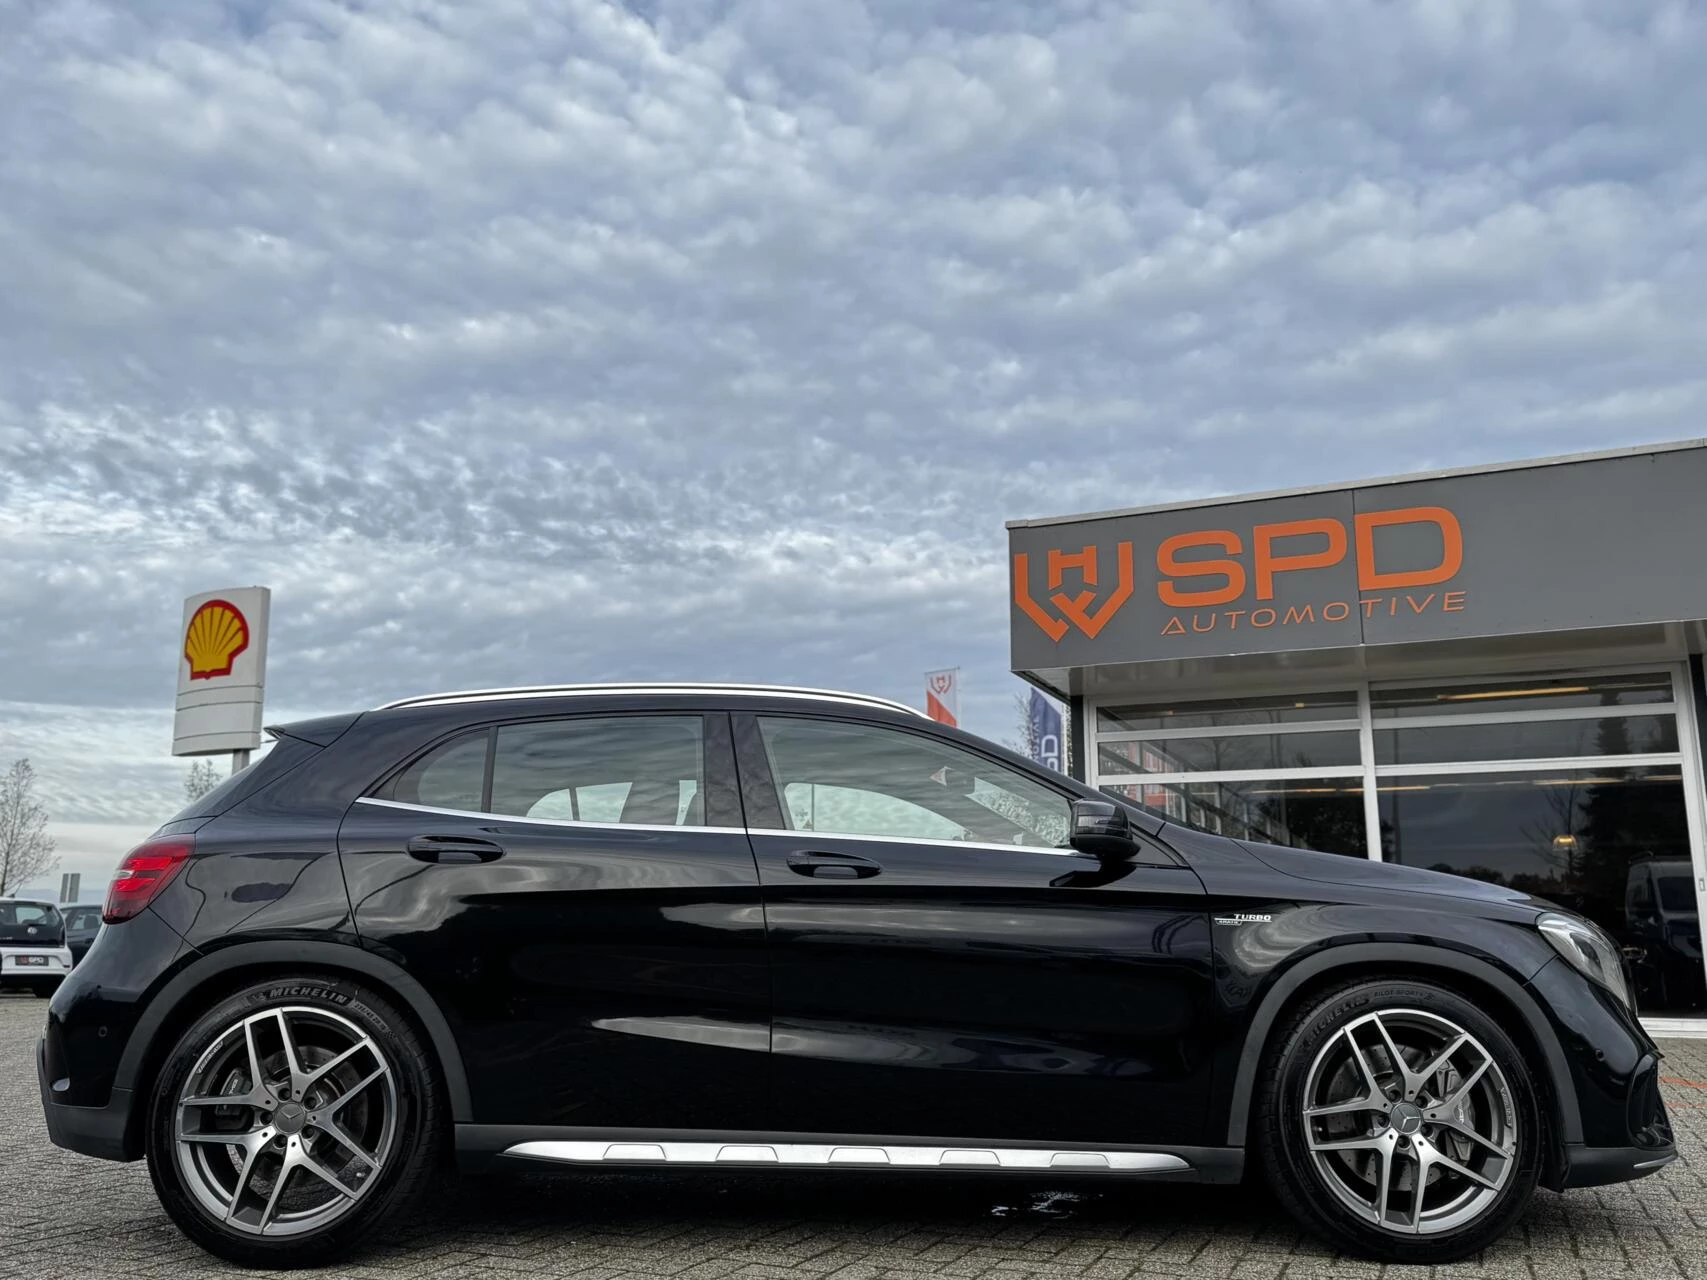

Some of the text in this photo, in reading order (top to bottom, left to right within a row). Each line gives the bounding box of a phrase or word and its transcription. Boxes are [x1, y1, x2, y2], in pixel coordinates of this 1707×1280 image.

[1156, 506, 1464, 608] SPD
[1160, 591, 1468, 636] AUTOMOTIVE
[1233, 913, 1272, 921] TURBO
[269, 985, 349, 1004] MICHELIN
